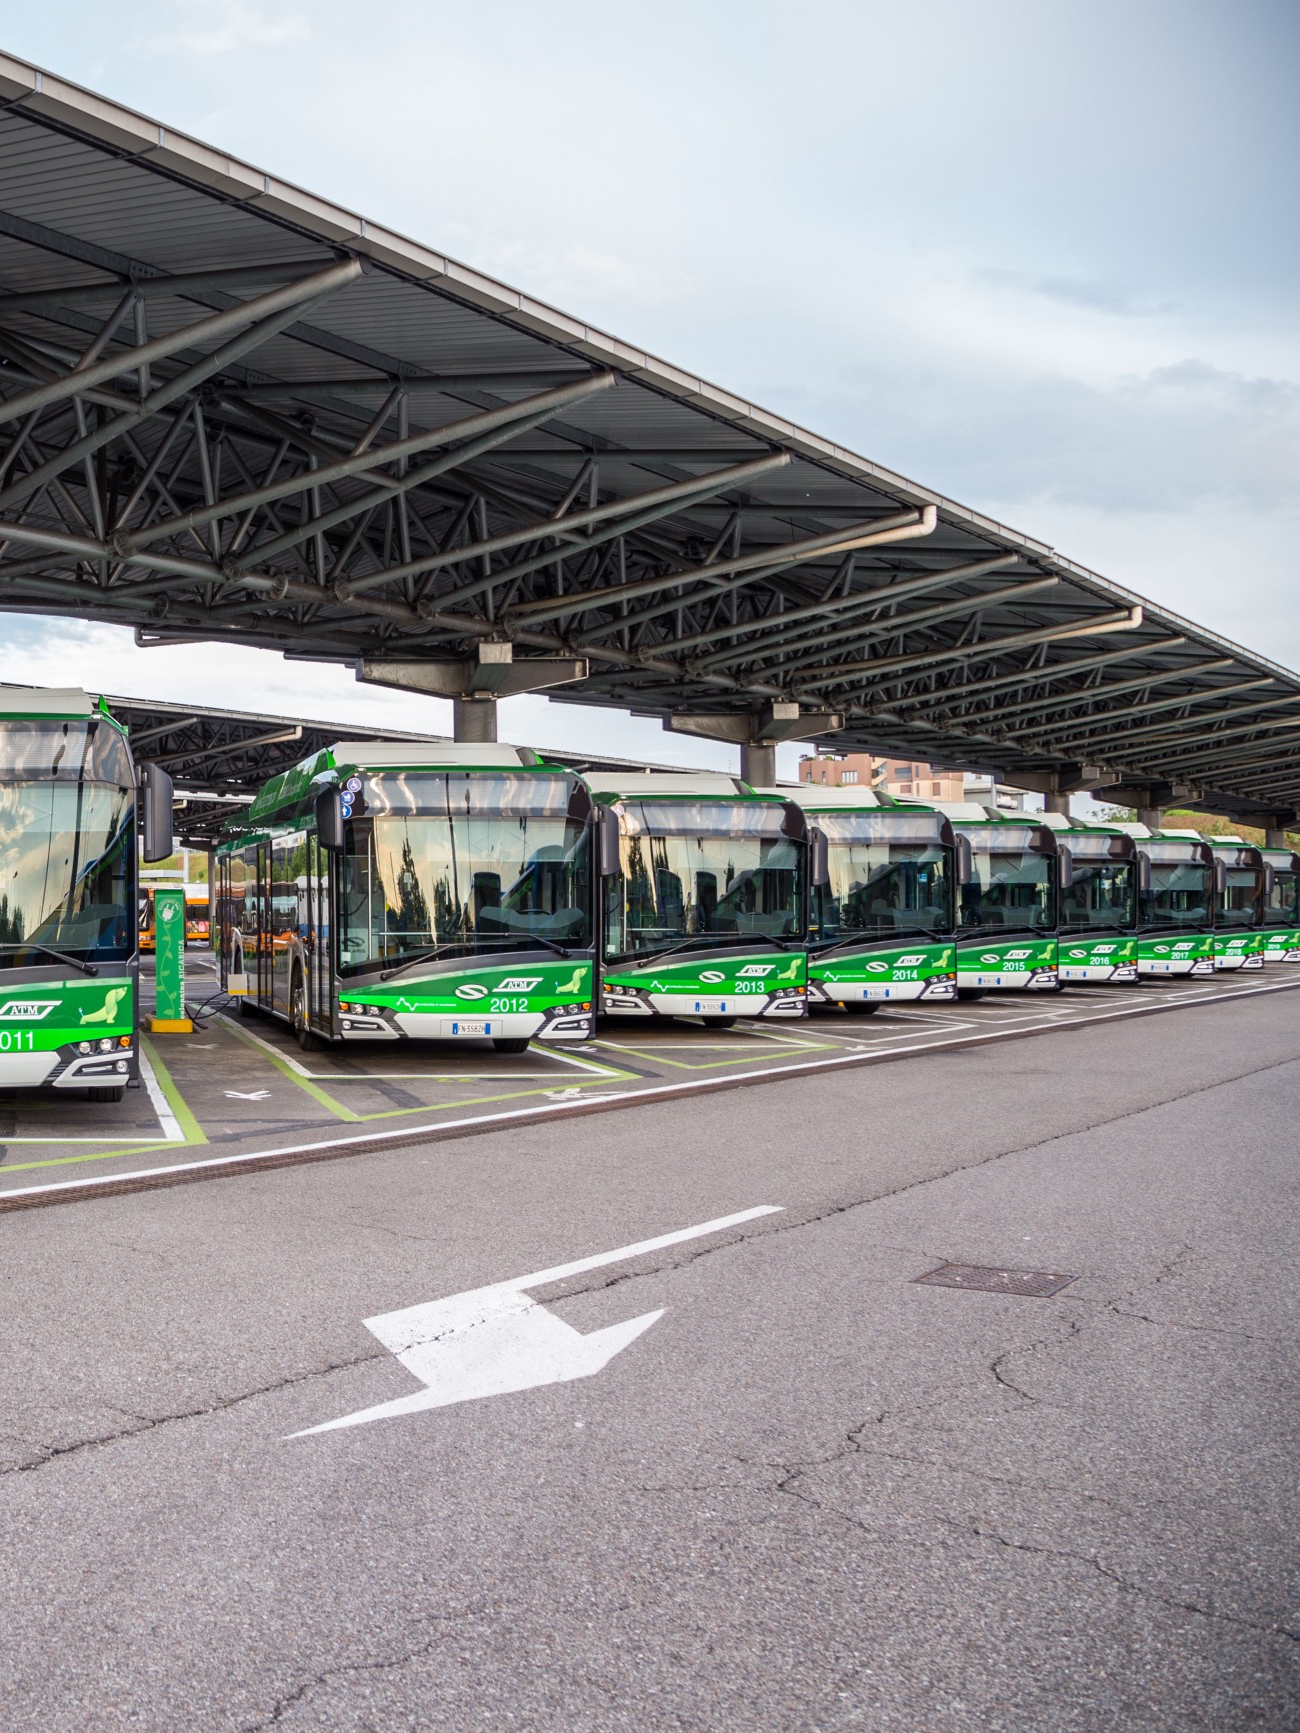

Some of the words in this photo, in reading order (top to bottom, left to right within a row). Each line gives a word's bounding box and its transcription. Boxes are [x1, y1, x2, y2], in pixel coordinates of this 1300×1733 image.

[1171, 952, 1189, 960] 2017
[1225, 948, 1242, 956] 2018
[1089, 956, 1110, 965] 2016
[1003, 962, 1026, 971] 2015
[892, 970, 918, 981] 2014
[507, 981, 528, 989] ATM
[734, 982, 765, 993] 2013
[9, 1005, 39, 1015] ATM
[490, 998, 528, 1013] 2012
